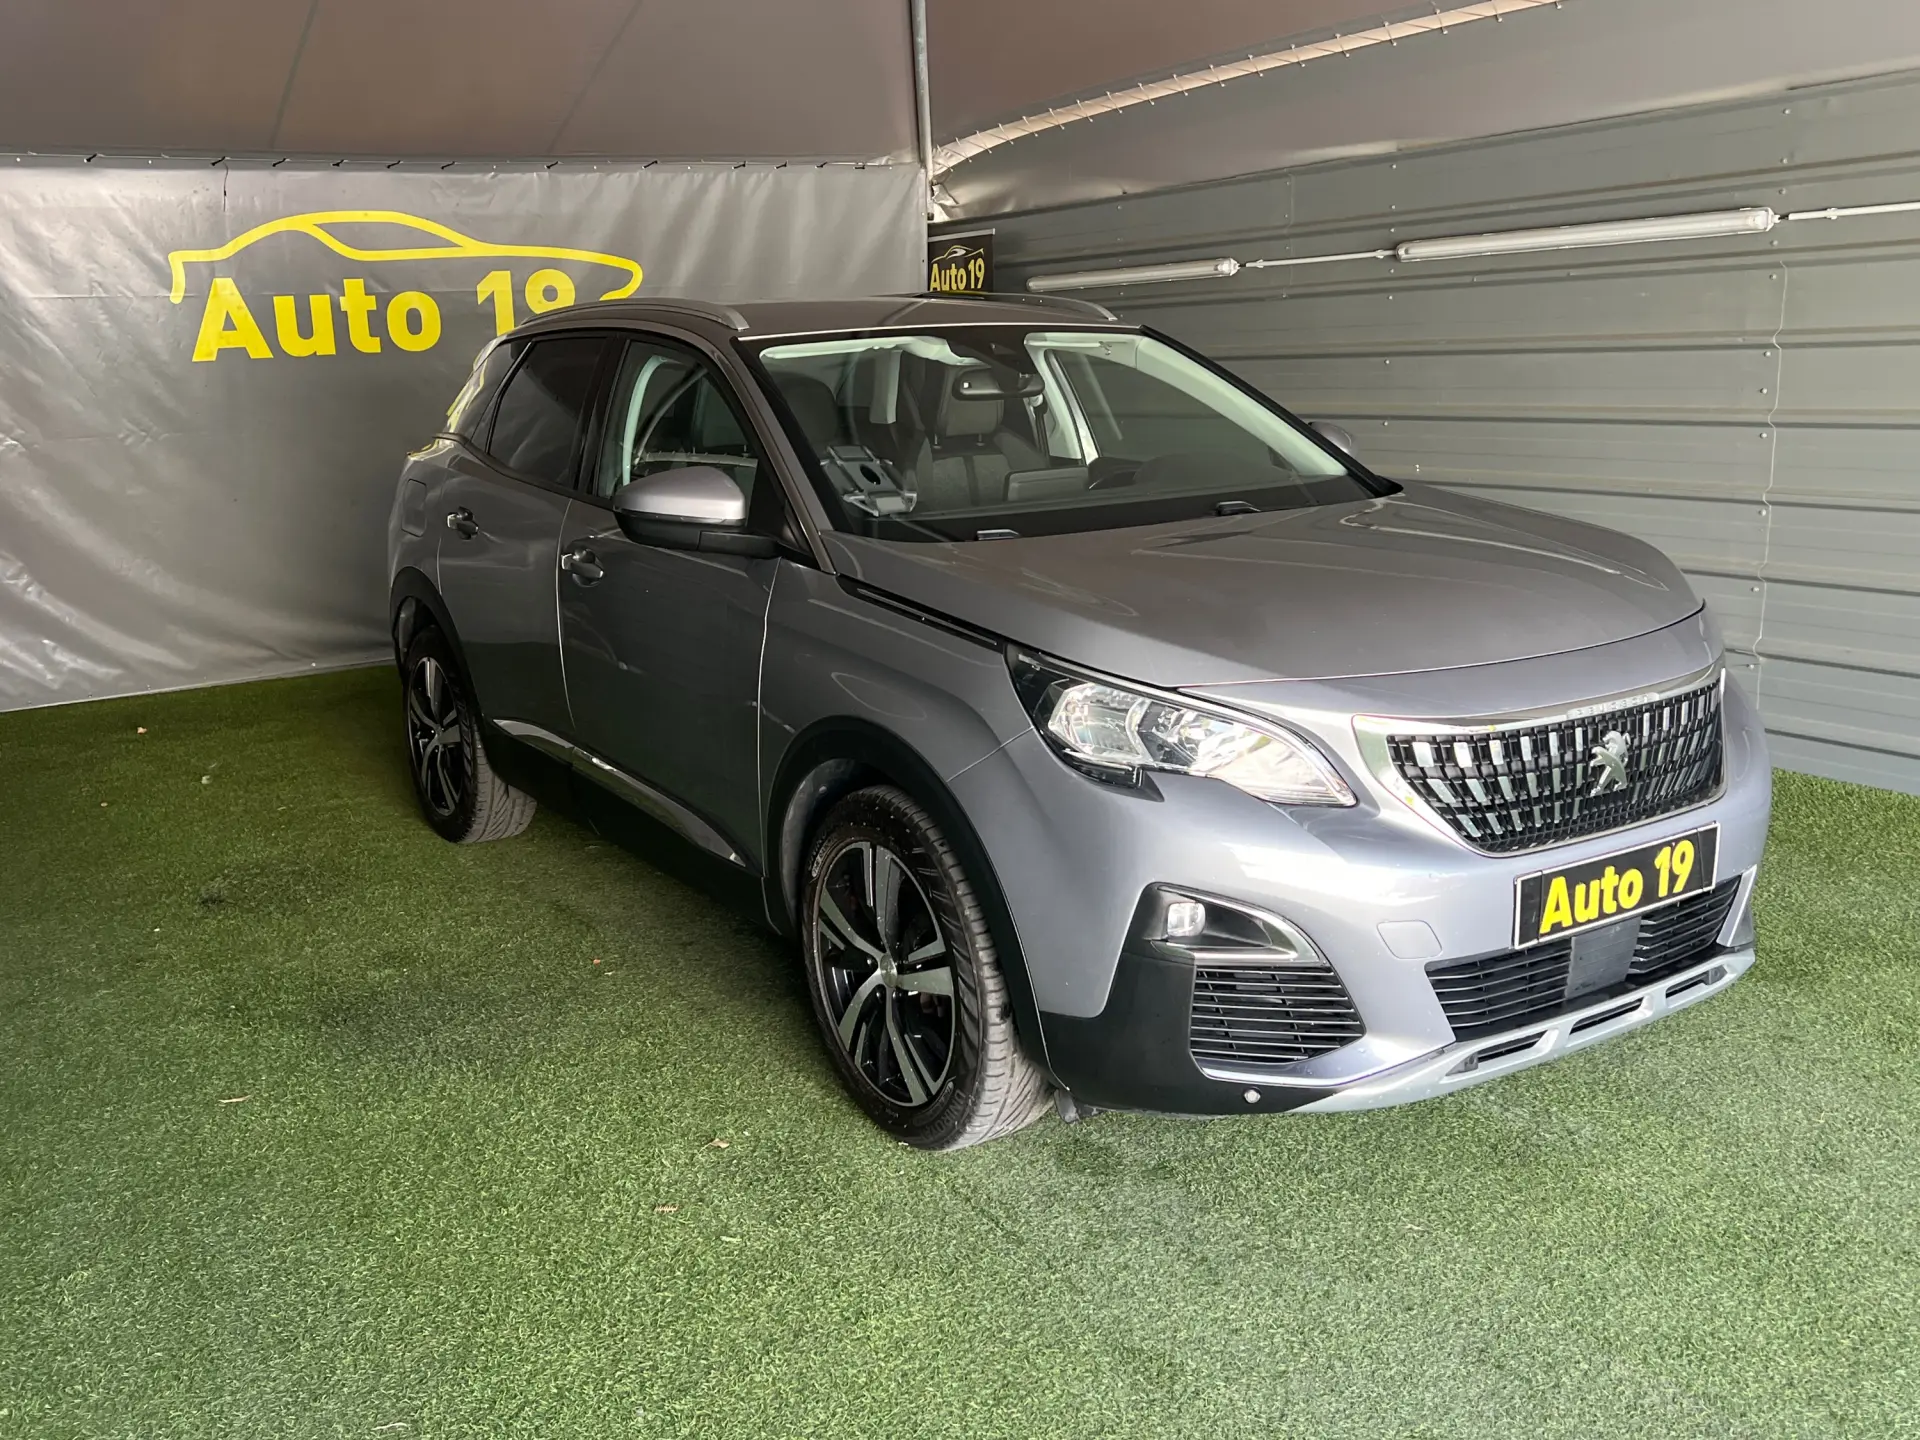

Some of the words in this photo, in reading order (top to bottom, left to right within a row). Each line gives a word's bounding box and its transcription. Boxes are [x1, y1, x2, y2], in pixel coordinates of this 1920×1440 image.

[929, 263, 967, 292] Auto
[968, 257, 985, 289] 19
[192, 277, 441, 362] Auto
[476, 267, 576, 336] 19
[1539, 866, 1644, 934] Auto
[1654, 839, 1695, 897] 19
[918, 1088, 967, 1141] UNIROYA
